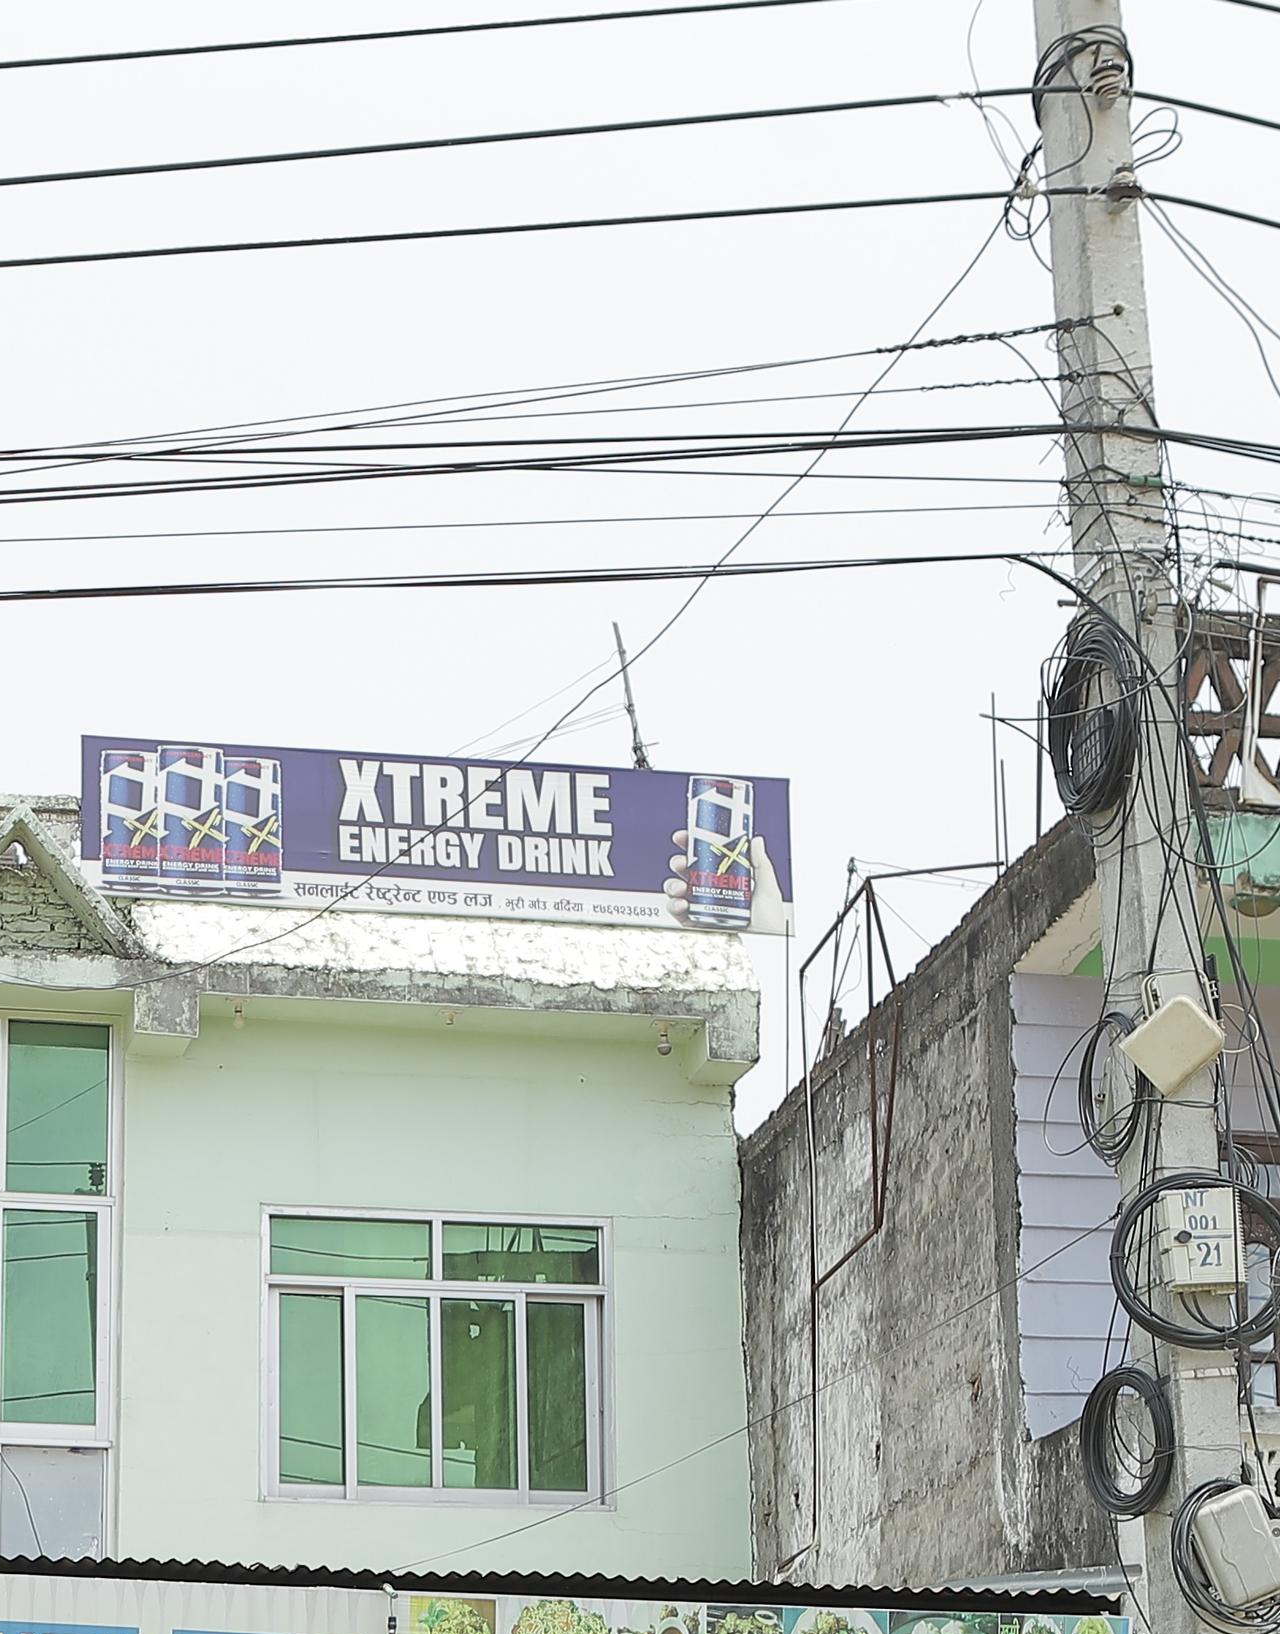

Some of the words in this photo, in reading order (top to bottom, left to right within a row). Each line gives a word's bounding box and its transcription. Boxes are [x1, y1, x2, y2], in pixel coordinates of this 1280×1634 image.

[339, 759, 613, 836] XTREME
[339, 825, 485, 869] ENERGY
[498, 835, 615, 877] DRINK
[689, 870, 749, 891] XTREME
[427, 890, 458, 906] एण्ड
[464, 892, 493, 908] लज
[1184, 1190, 1209, 1208] NT
[1189, 1214, 1218, 1230] 001
[1196, 1241, 1223, 1267] 21
